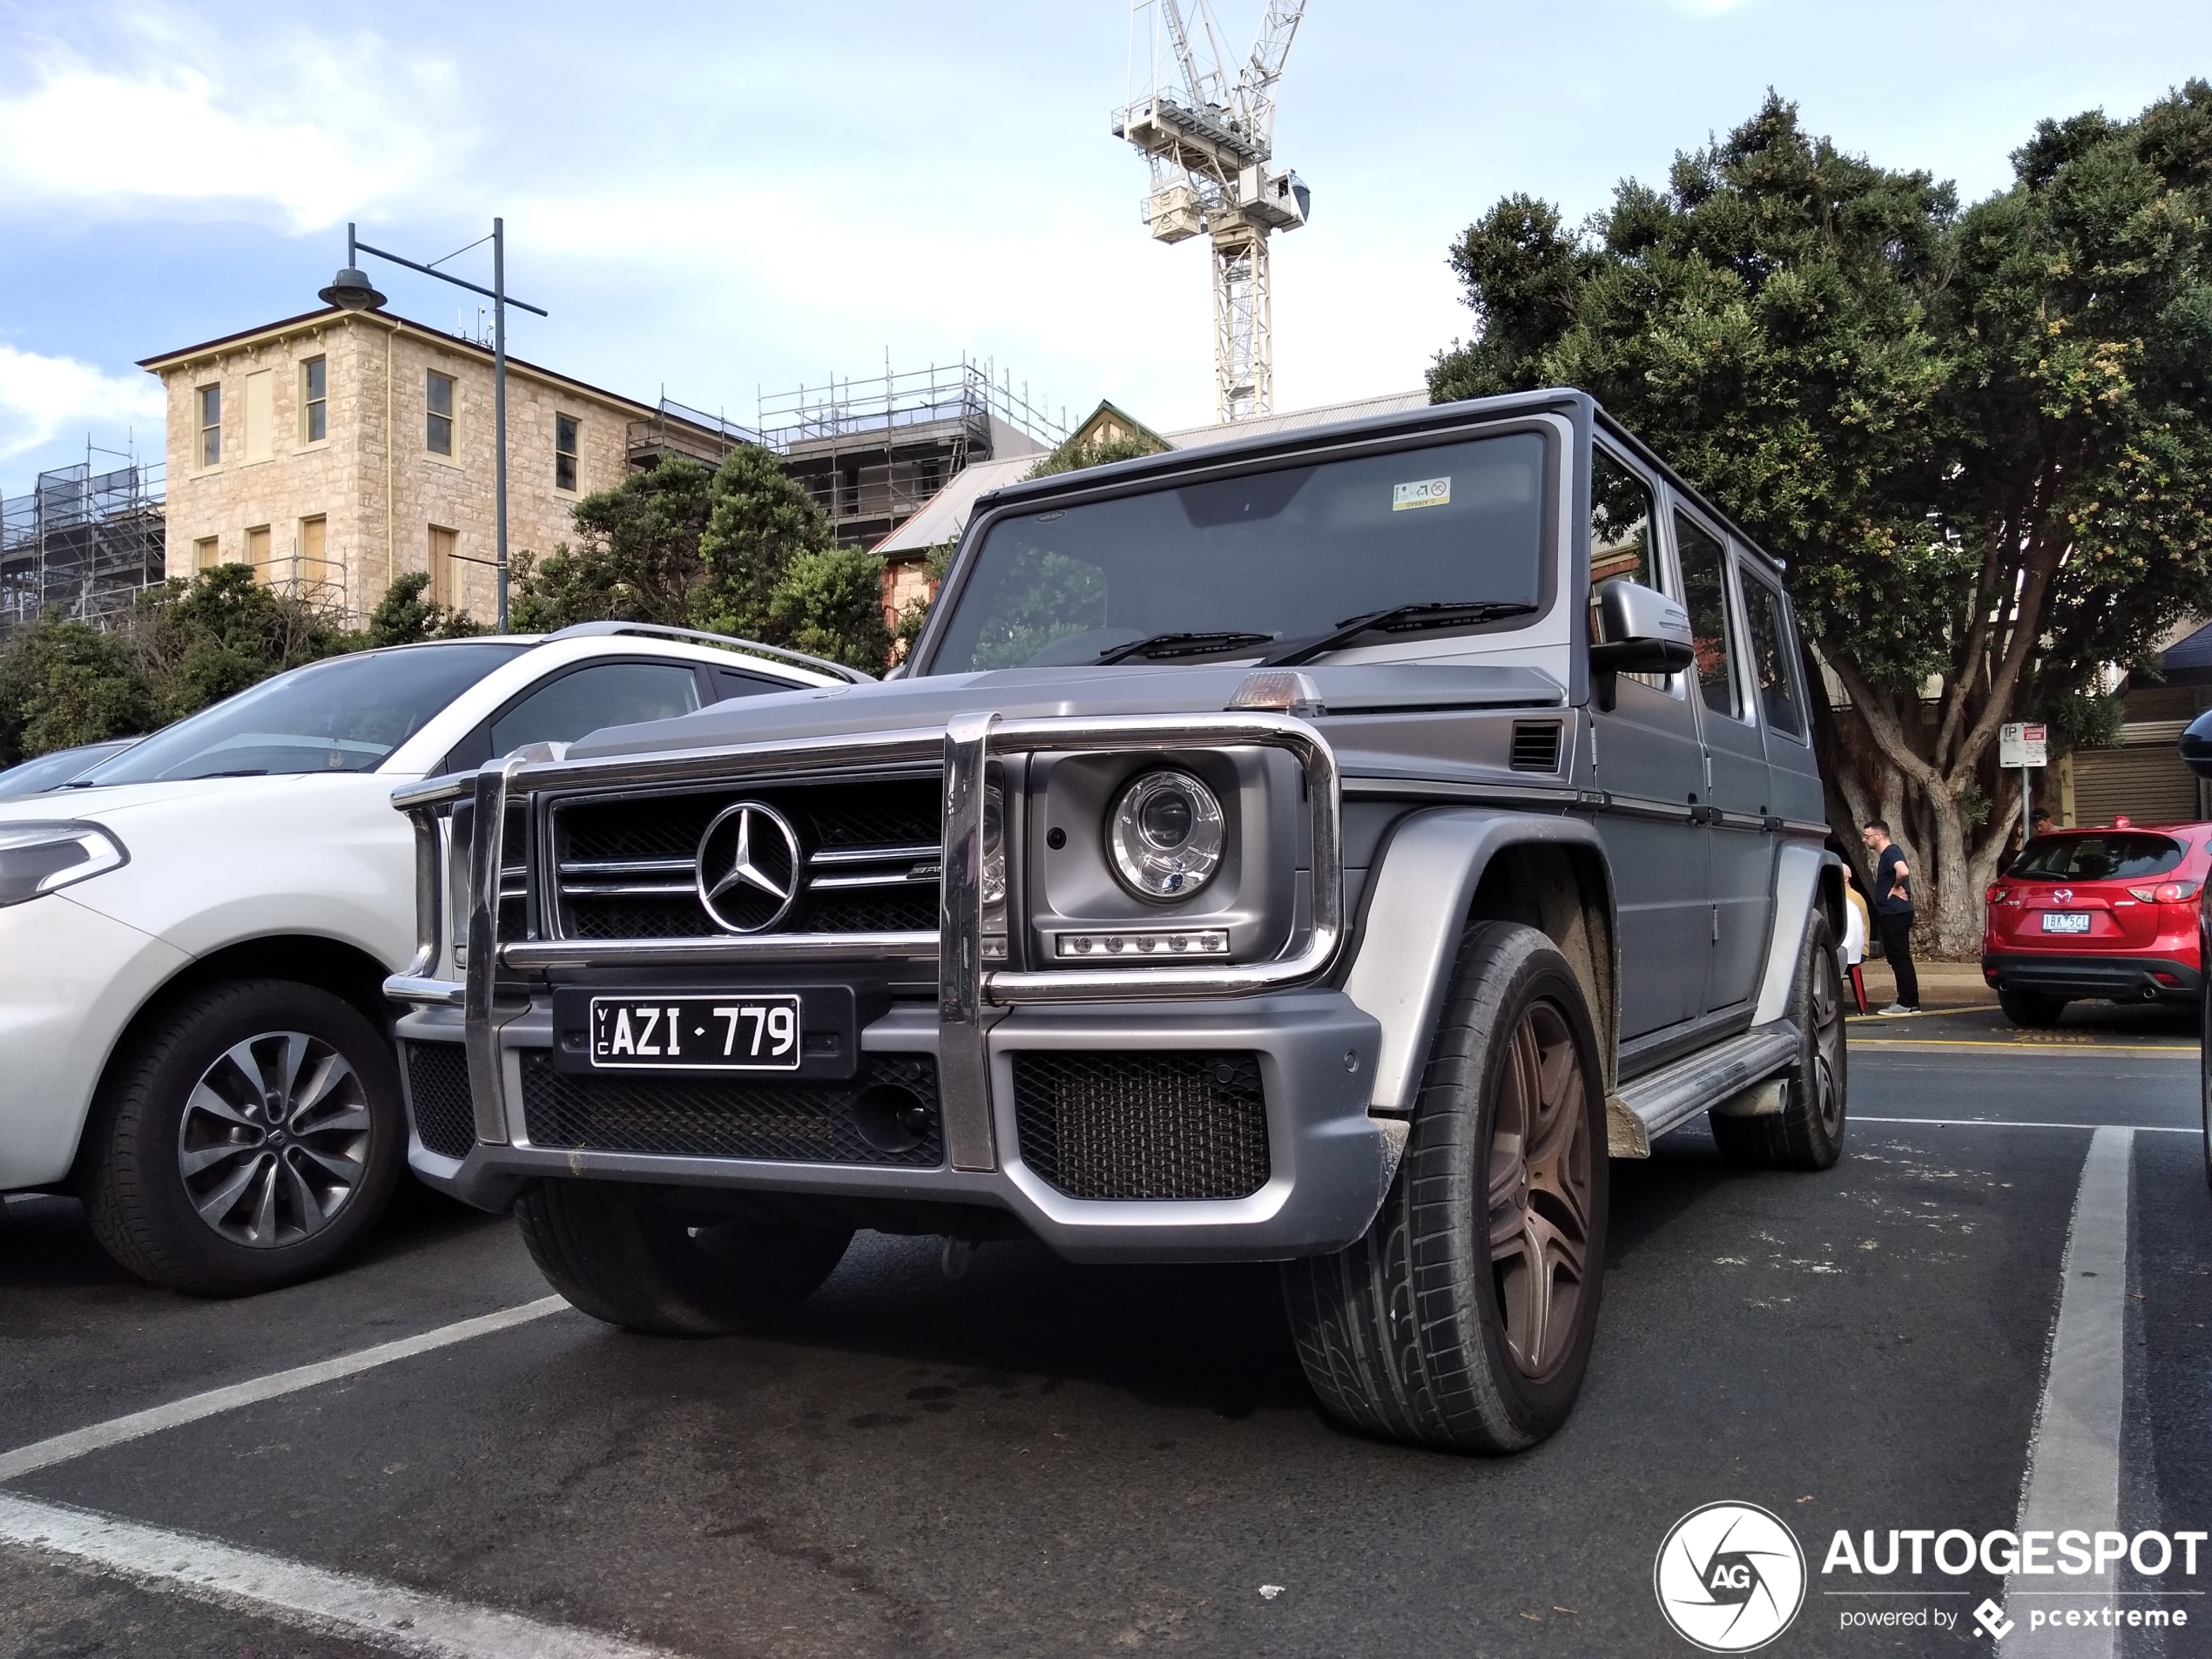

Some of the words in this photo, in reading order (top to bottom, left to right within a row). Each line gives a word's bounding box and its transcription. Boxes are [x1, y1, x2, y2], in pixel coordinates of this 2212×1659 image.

[2005, 727, 2017, 737] 1P
[2046, 916, 2062, 927] 1BK
[2070, 916, 2087, 927] 5CL
[597, 1008, 610, 1055] VIC
[611, 1007, 681, 1055] AZI
[712, 1007, 794, 1056] 779
